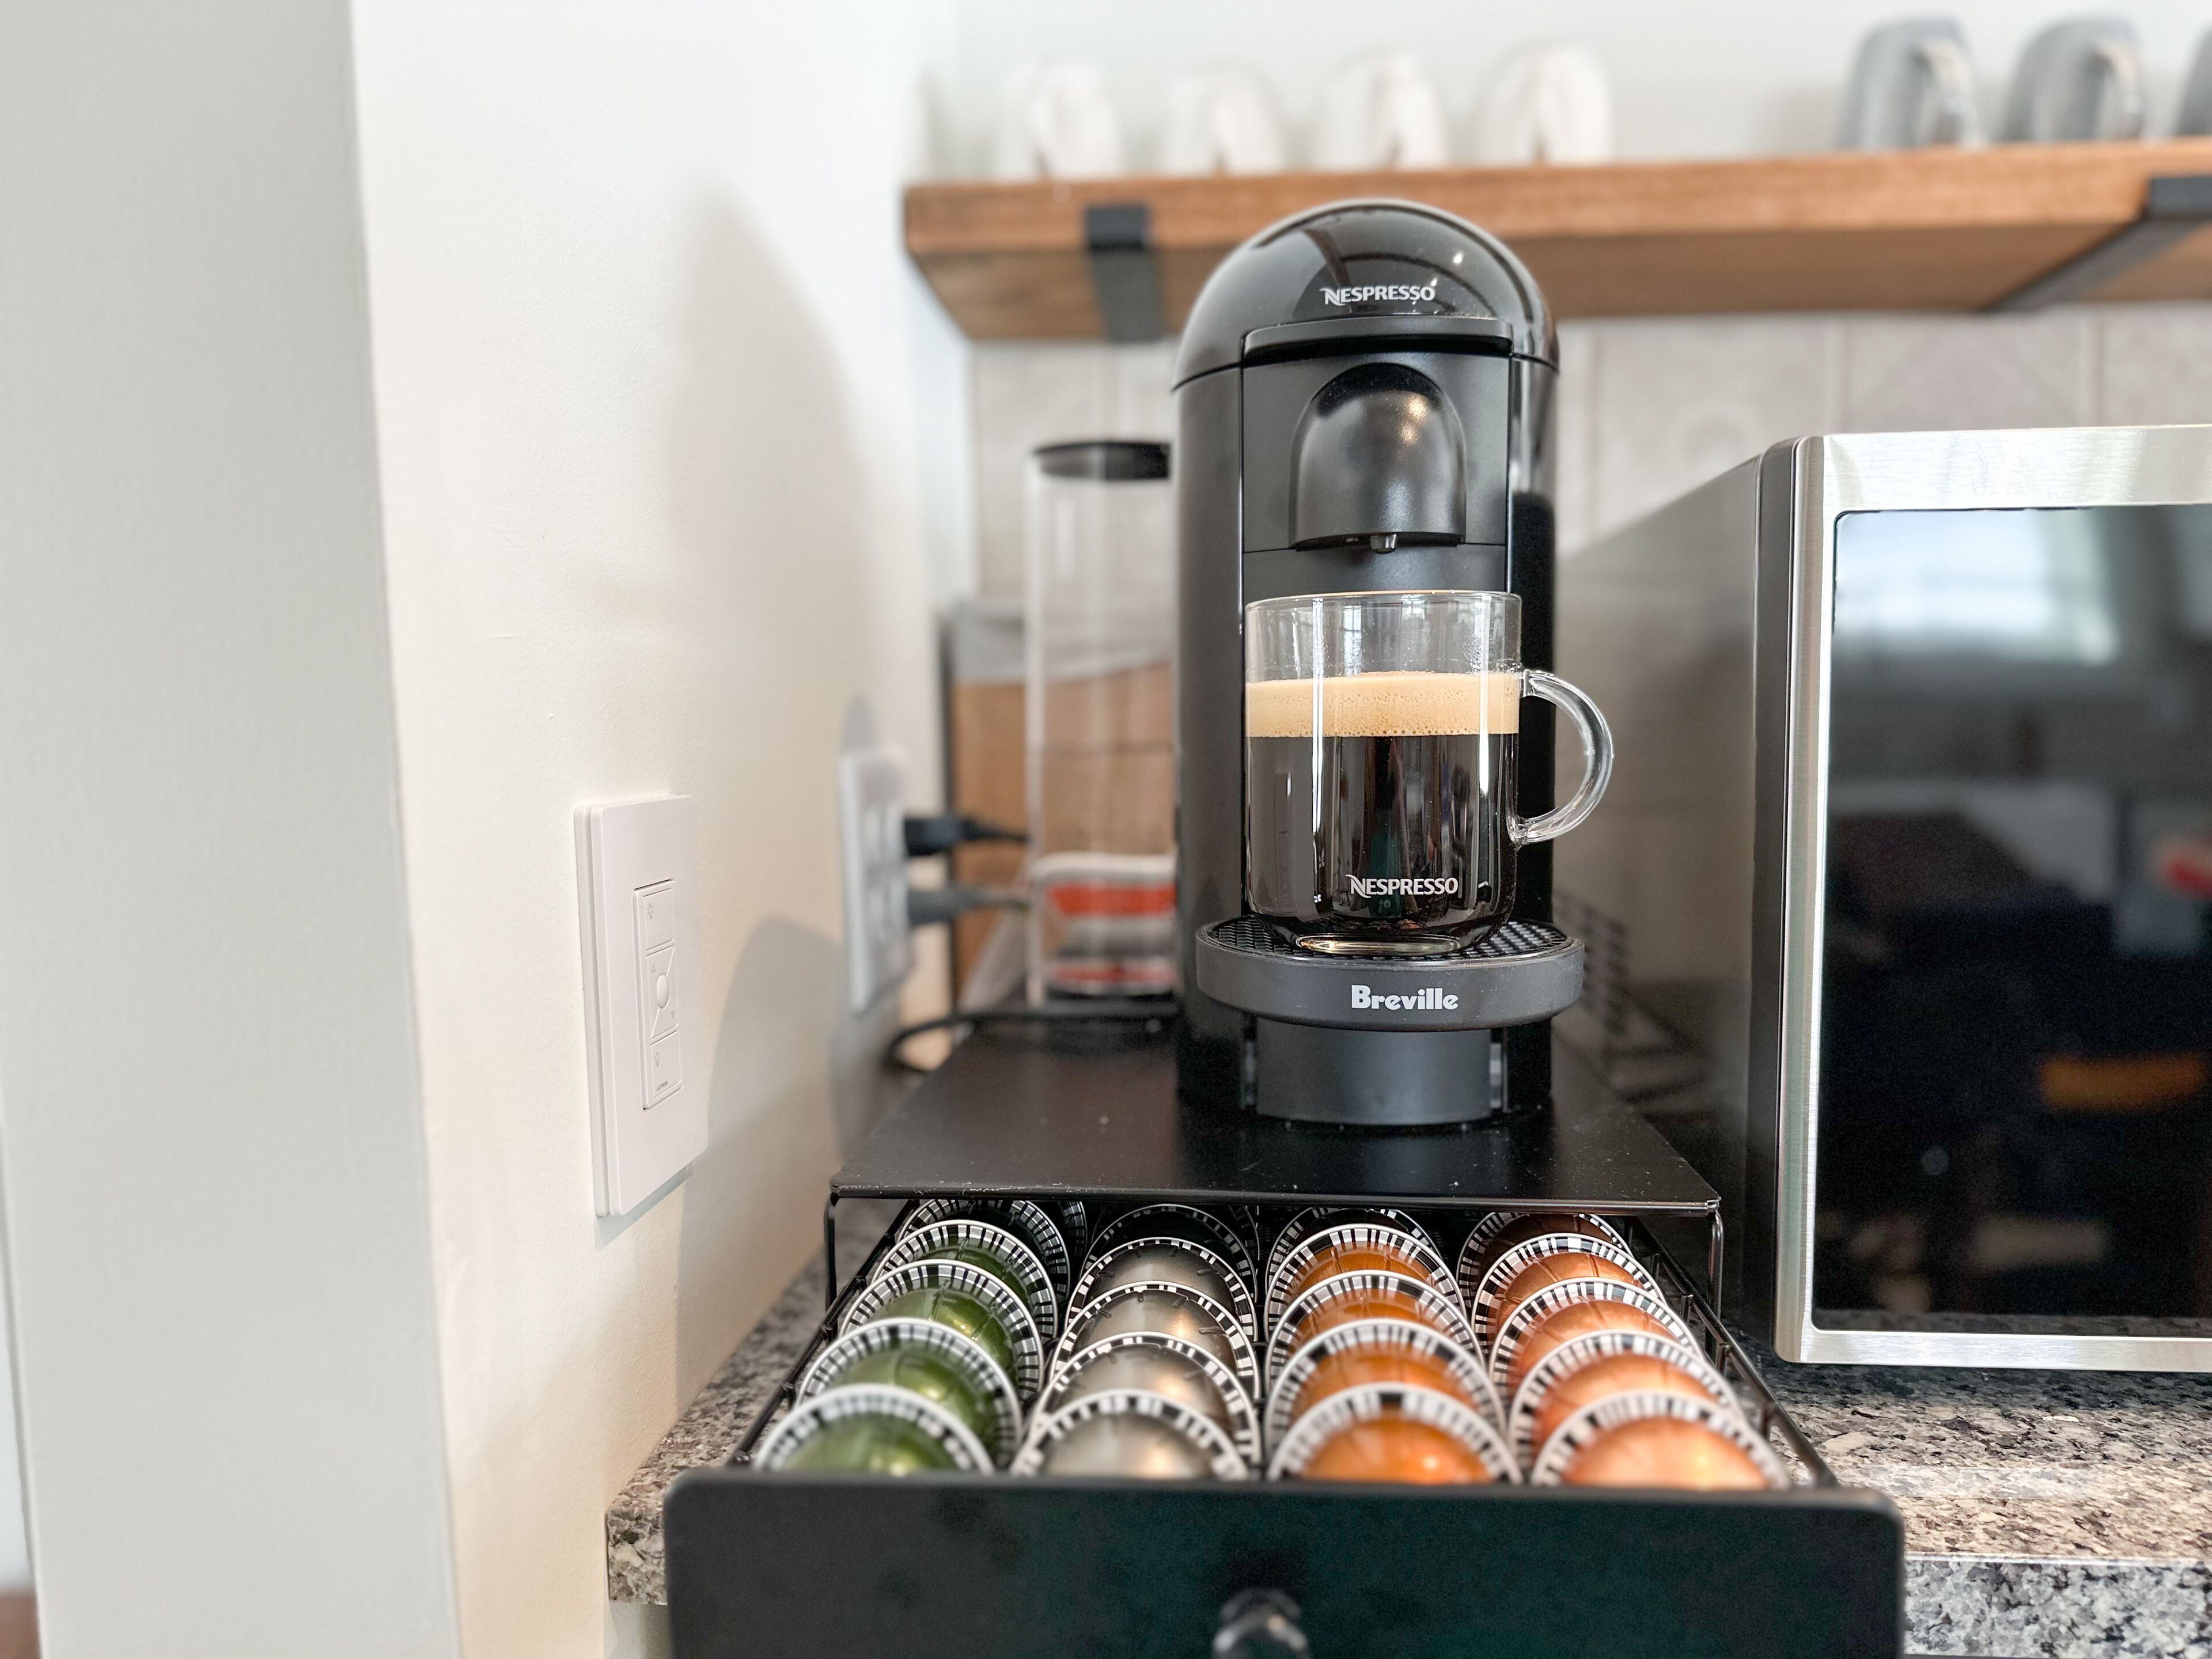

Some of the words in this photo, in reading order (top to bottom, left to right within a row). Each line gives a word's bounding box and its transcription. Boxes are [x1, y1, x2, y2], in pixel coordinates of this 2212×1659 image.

[1319, 286, 1435, 306] NESPRESSO
[1345, 874, 1459, 898] NESPRESSO
[1351, 984, 1459, 1010] Breville
